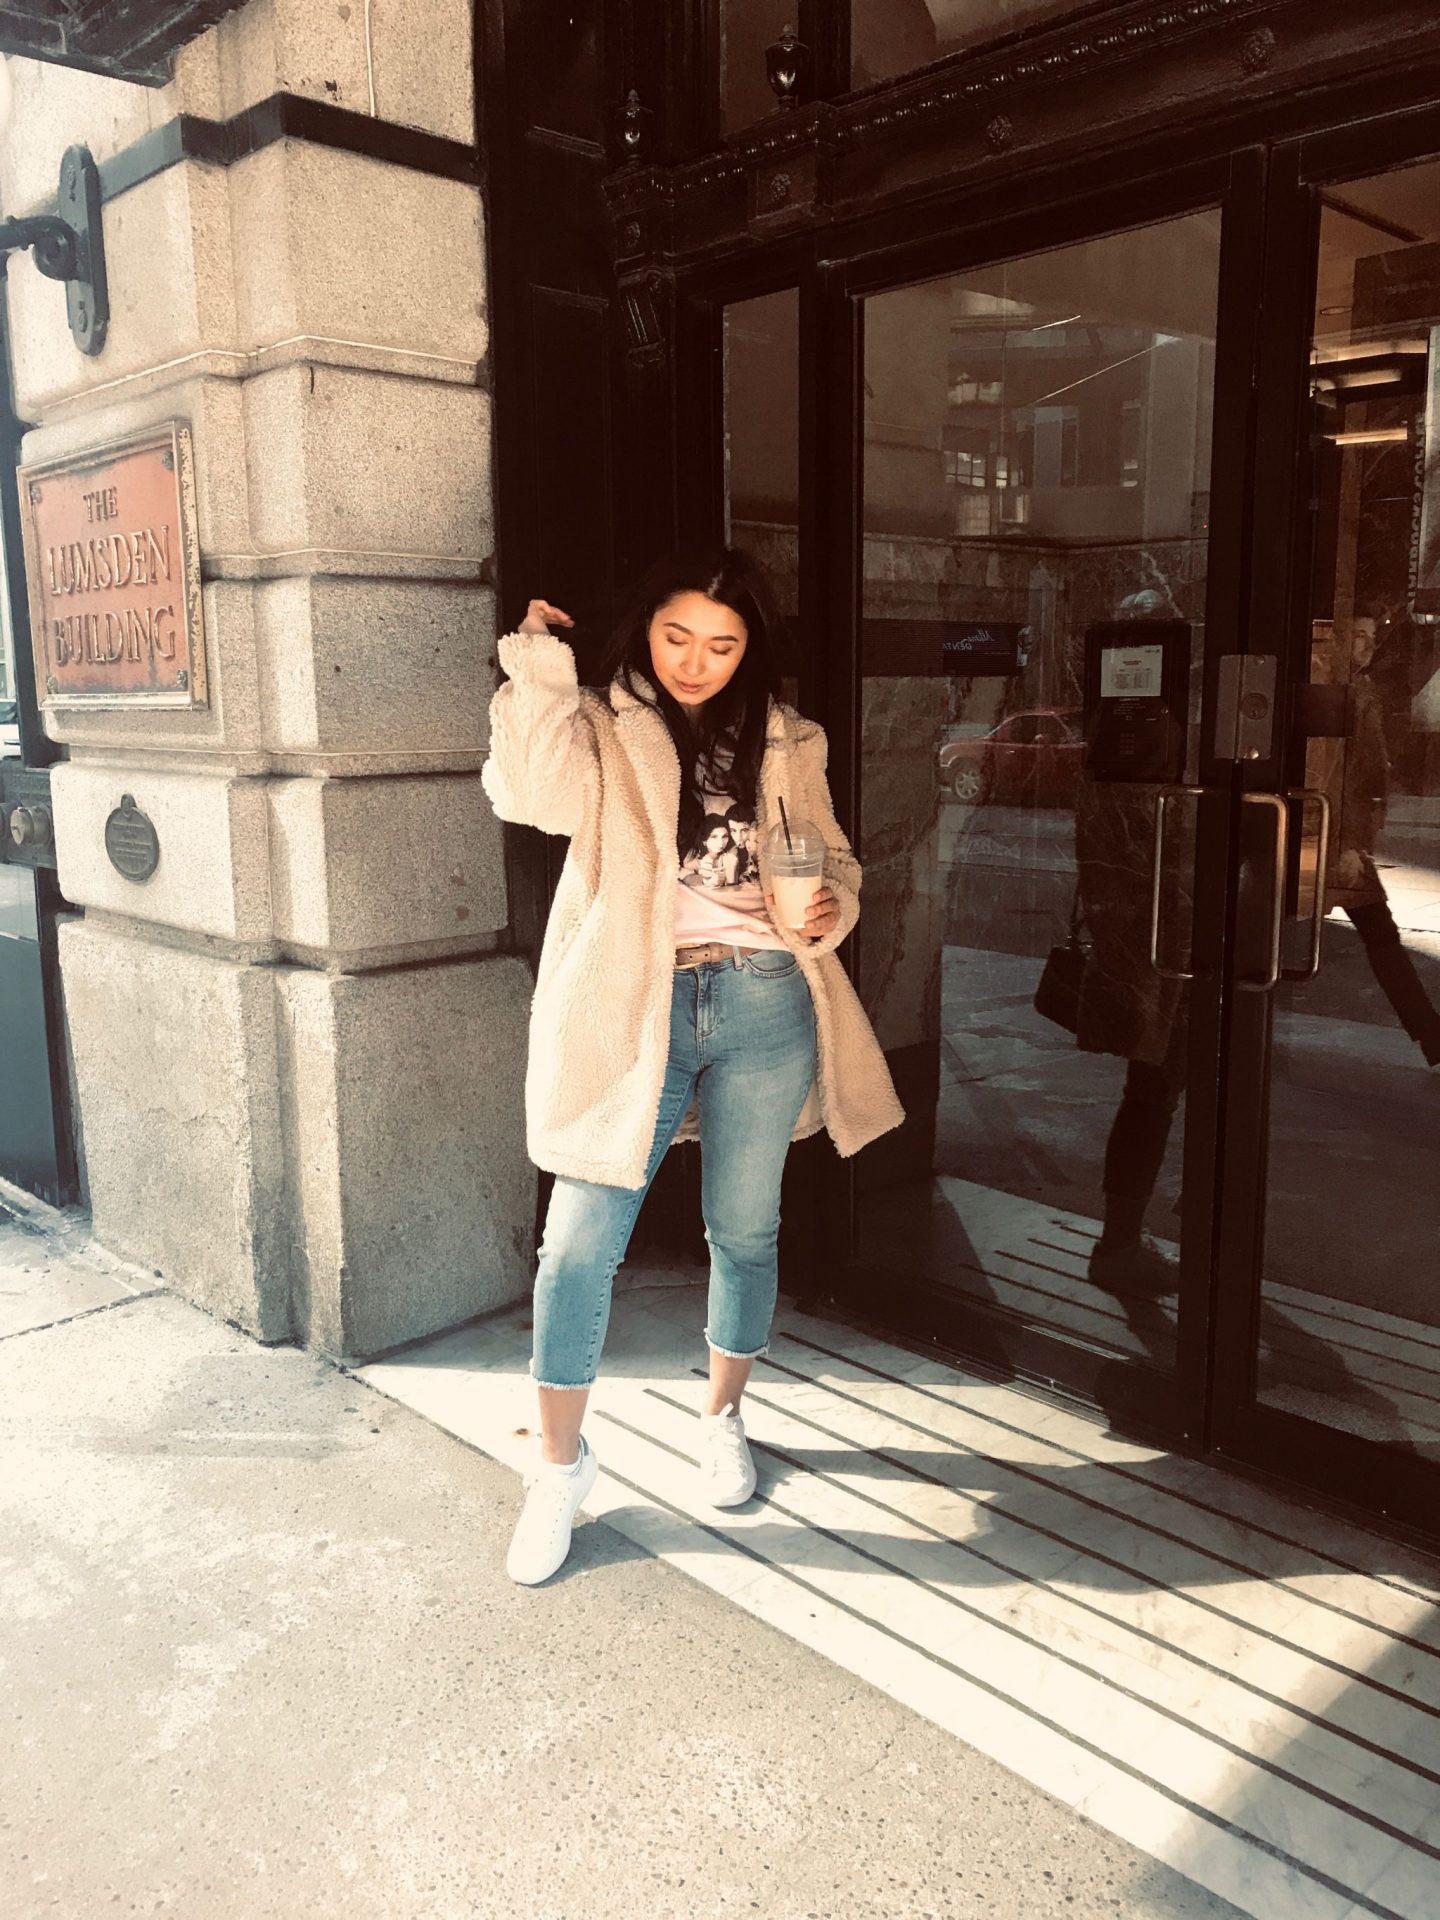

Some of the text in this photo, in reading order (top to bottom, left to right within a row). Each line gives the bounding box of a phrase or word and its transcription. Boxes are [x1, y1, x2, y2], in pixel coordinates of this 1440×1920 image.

[83, 486, 118, 522] THE
[48, 525, 171, 594] LUMSDEN
[53, 605, 175, 665] BUILDING
